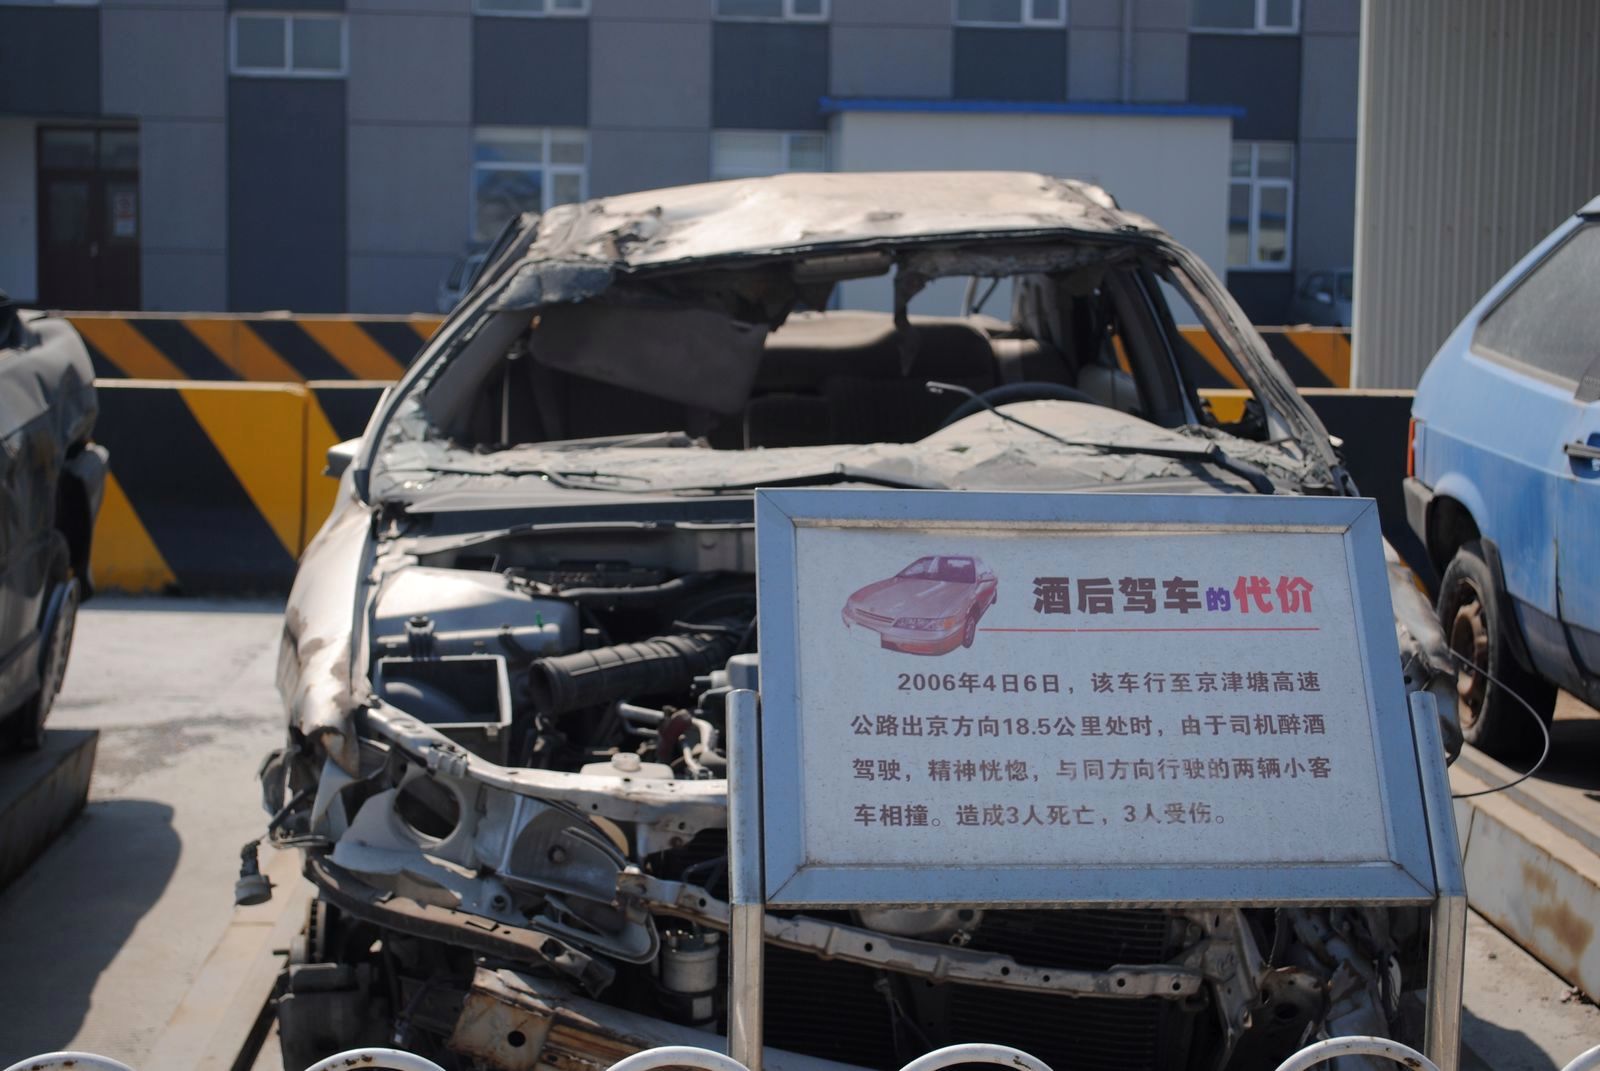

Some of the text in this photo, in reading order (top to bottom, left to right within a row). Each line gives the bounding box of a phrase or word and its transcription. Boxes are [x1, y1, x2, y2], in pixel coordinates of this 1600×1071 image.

[1032, 575, 1314, 615] 酒后驾车的代价
